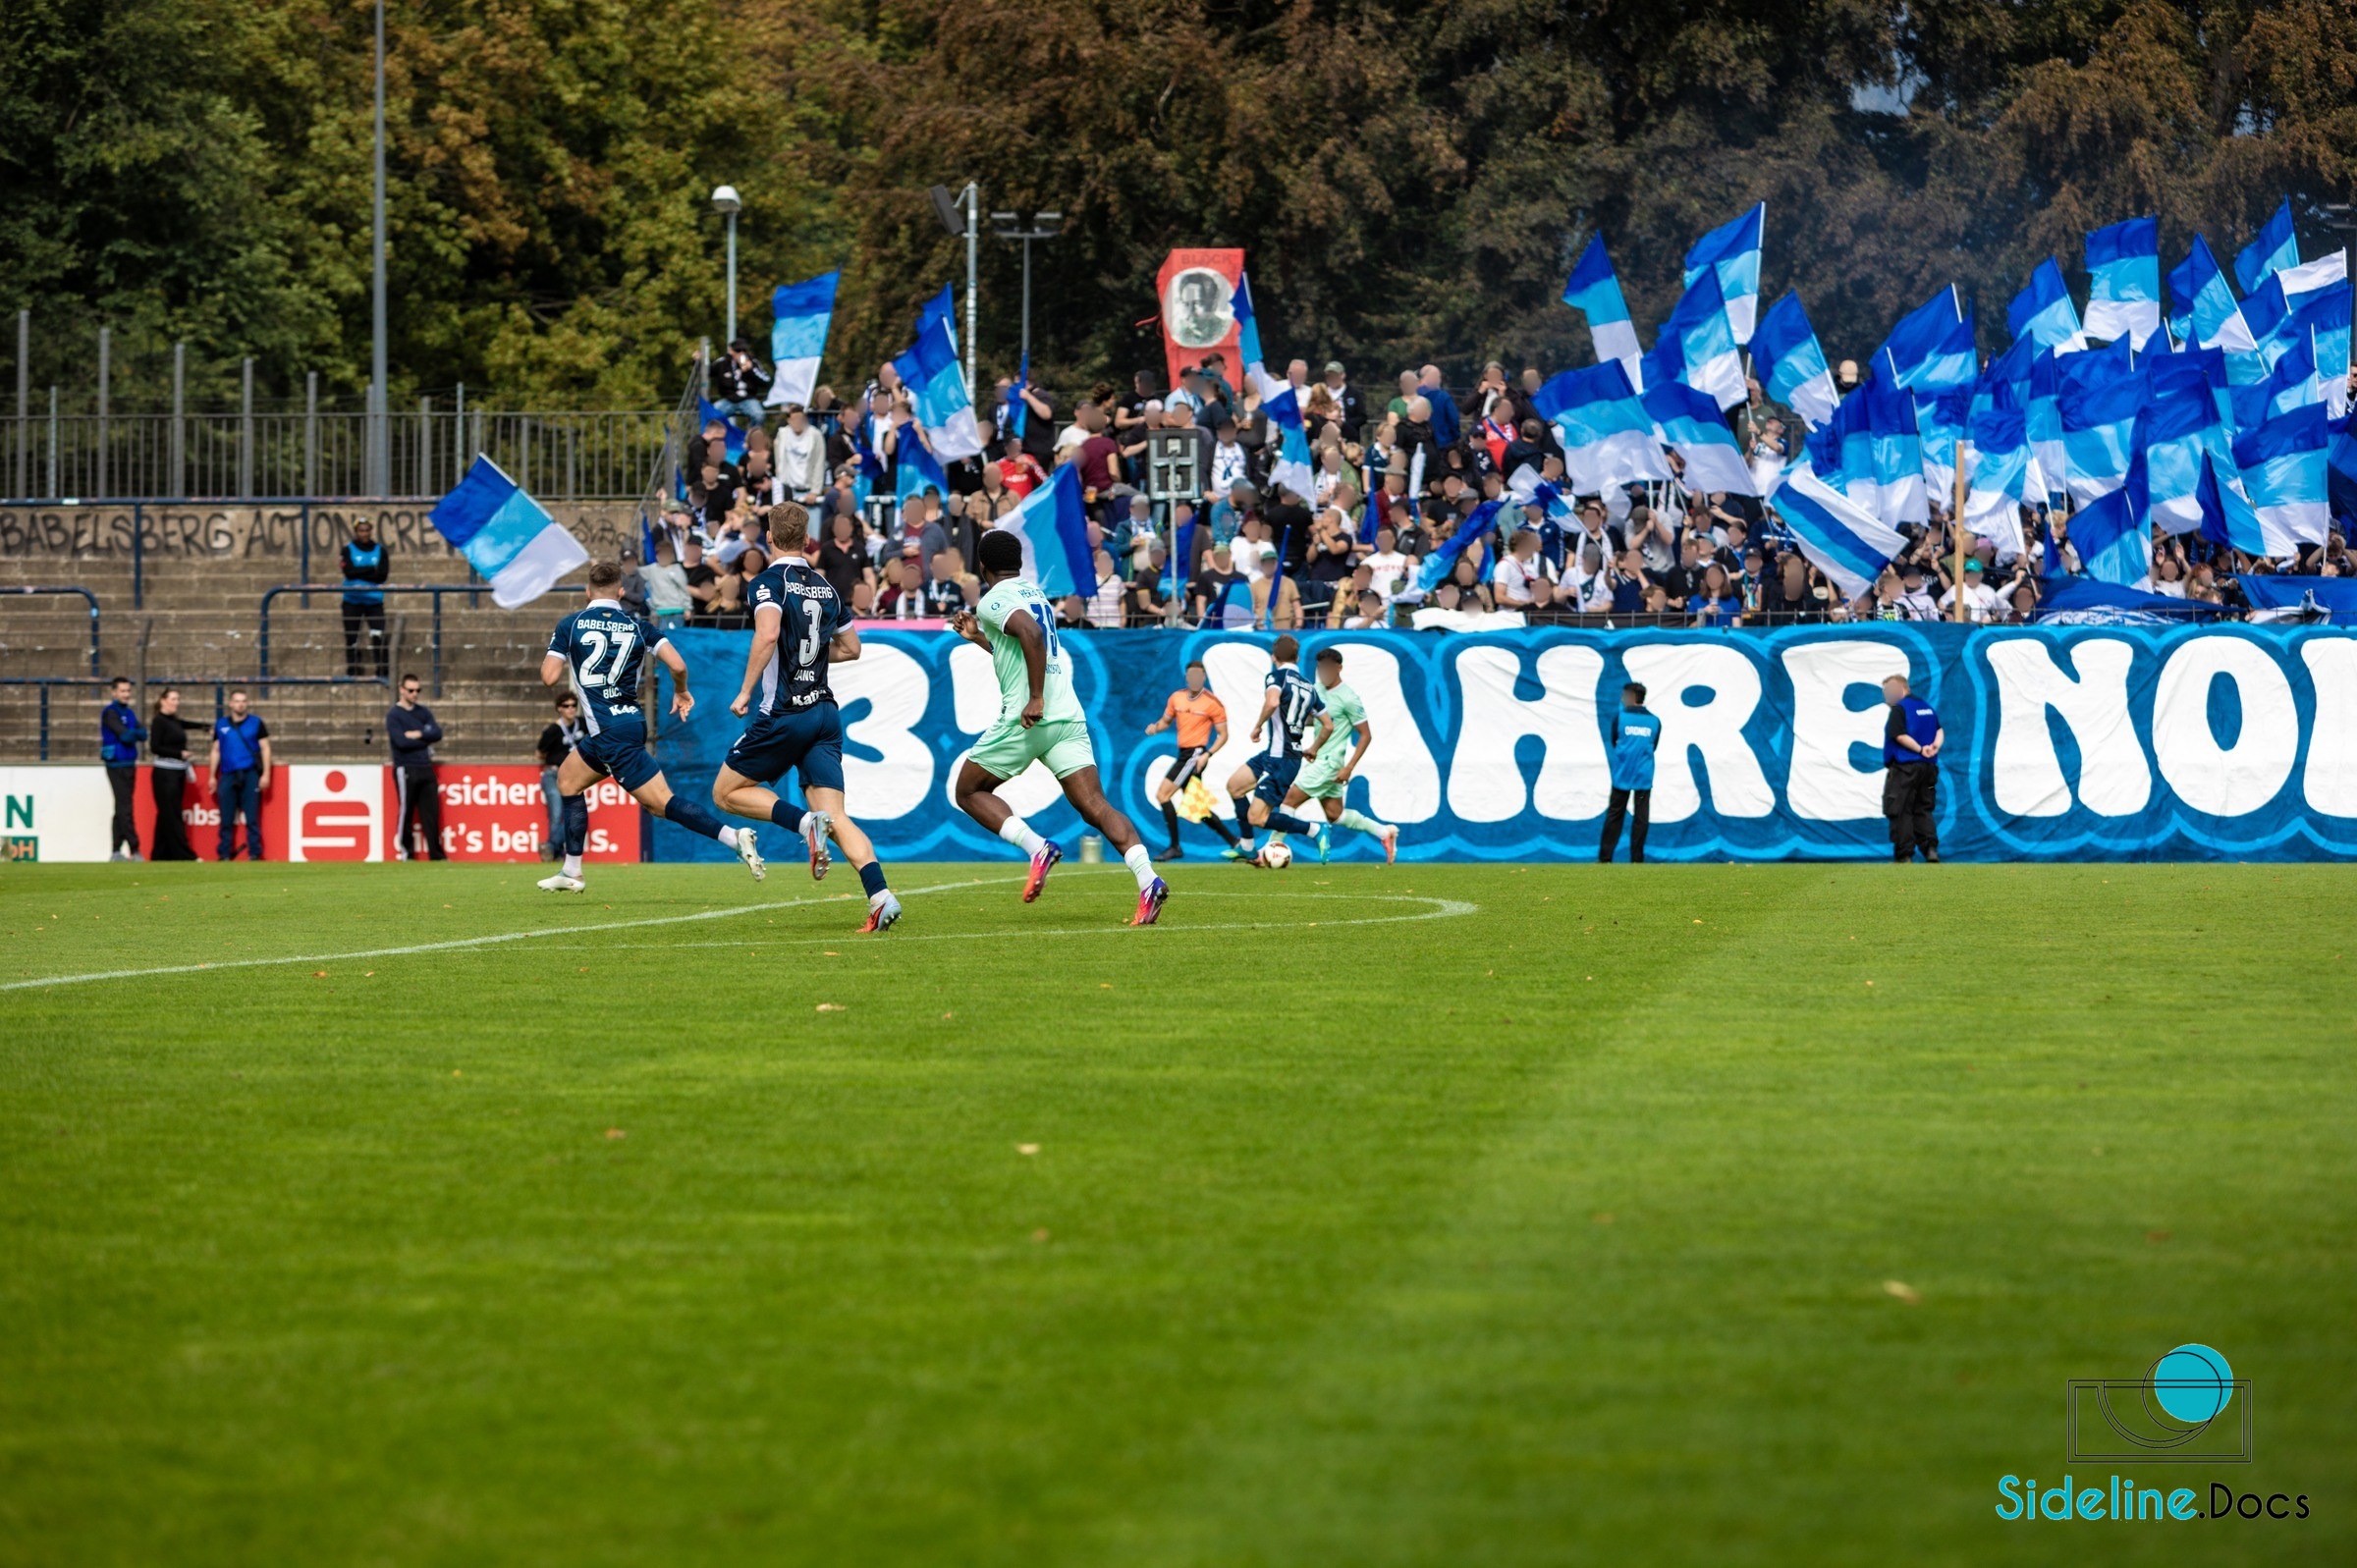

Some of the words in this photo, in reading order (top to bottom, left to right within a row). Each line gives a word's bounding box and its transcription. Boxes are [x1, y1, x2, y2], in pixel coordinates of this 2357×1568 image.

[376, 510, 456, 557] CRE
[787, 581, 834, 599] BABELSBERG
[577, 619, 635, 634] BABELSBERG
[798, 599, 823, 668] 3
[578, 630, 637, 688] 27
[794, 669, 816, 682] LANG
[1286, 684, 1312, 728] 17
[1145, 639, 1911, 824] JAHRE
[6, 794, 33, 829] N
[438, 775, 637, 812] sichergen
[490, 822, 539, 853] bei
